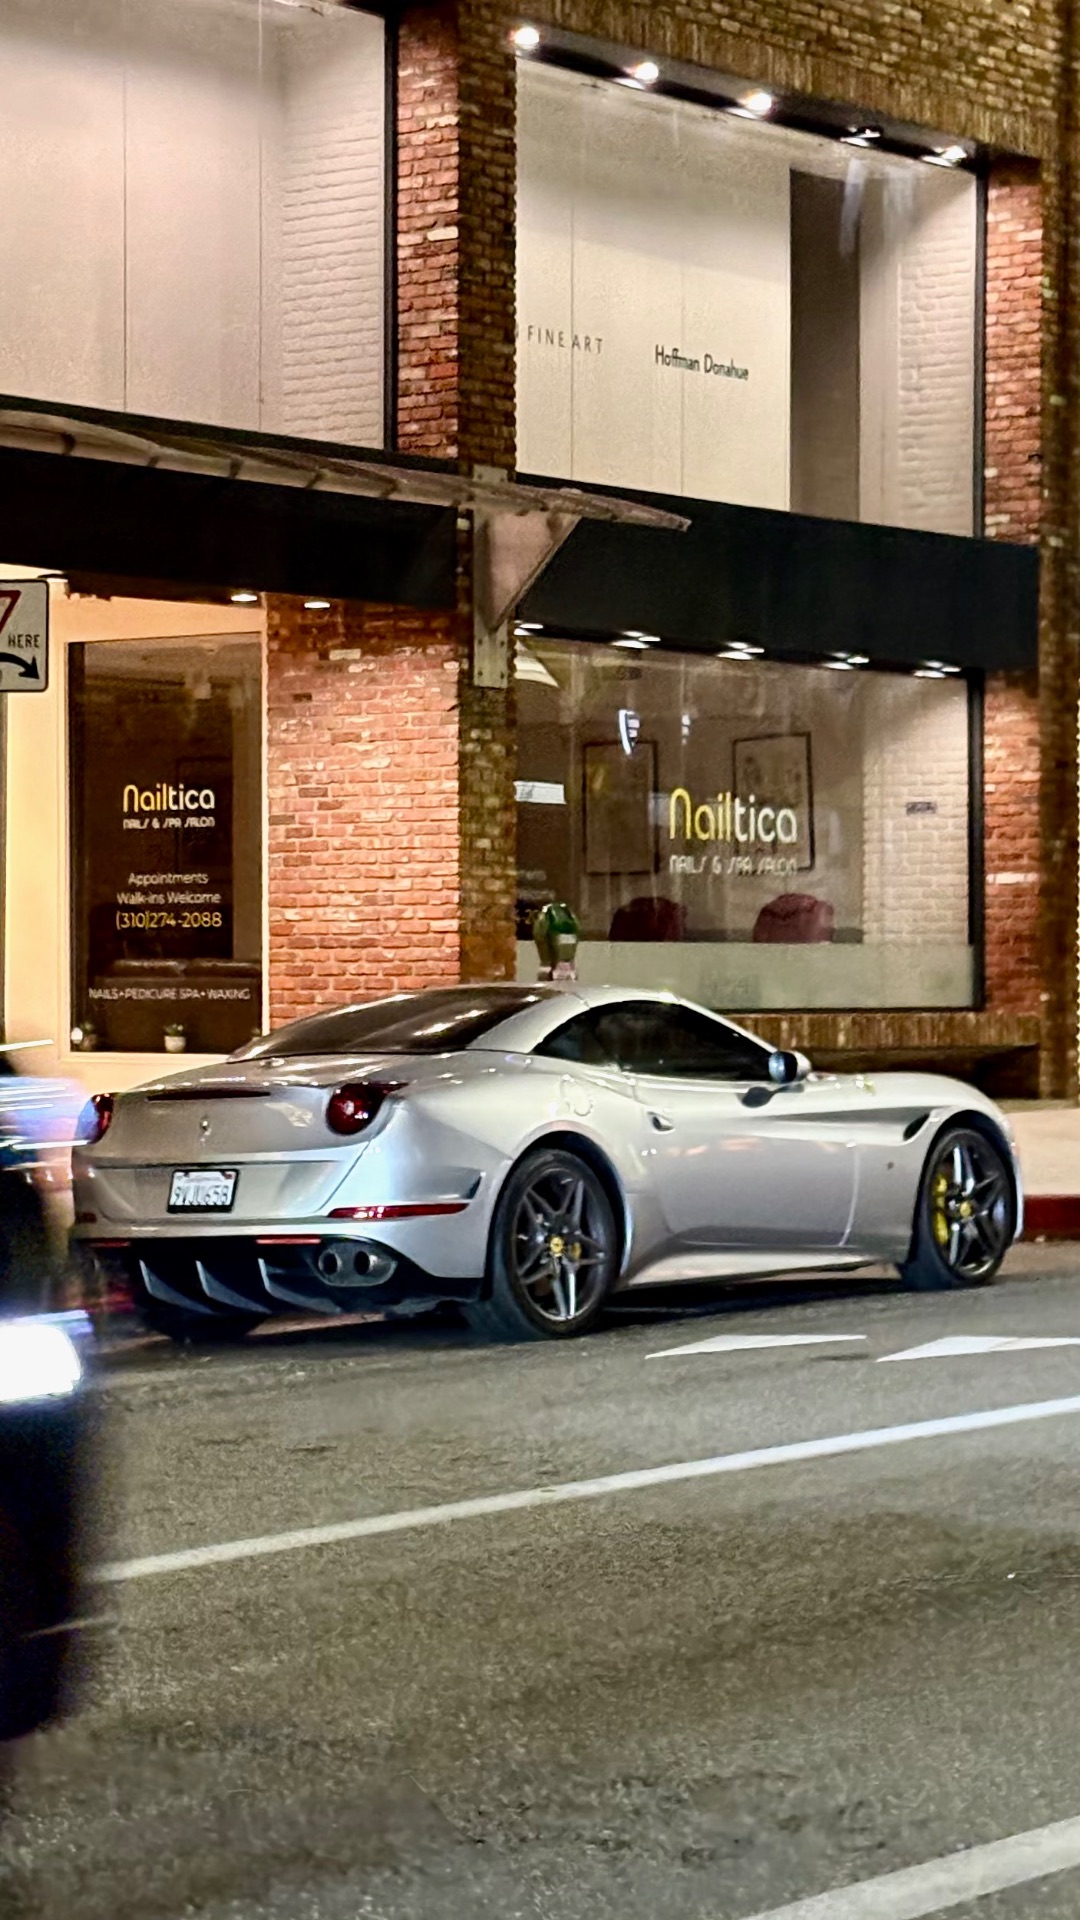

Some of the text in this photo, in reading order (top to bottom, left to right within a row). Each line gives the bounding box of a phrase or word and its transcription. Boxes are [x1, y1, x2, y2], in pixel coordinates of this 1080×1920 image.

[527, 325, 565, 348] FINE
[571, 334, 603, 354] ART
[655, 344, 749, 380] Hoffman Donahue
[8, 633, 40, 649] HERE
[123, 783, 215, 812] Nailtica
[669, 788, 797, 843] Nailtica
[669, 855, 707, 874] NAILS
[128, 872, 209, 887] Appointments
[116, 891, 222, 904] Walk-ins Welcome
[116, 911, 222, 930] (310)274-2088
